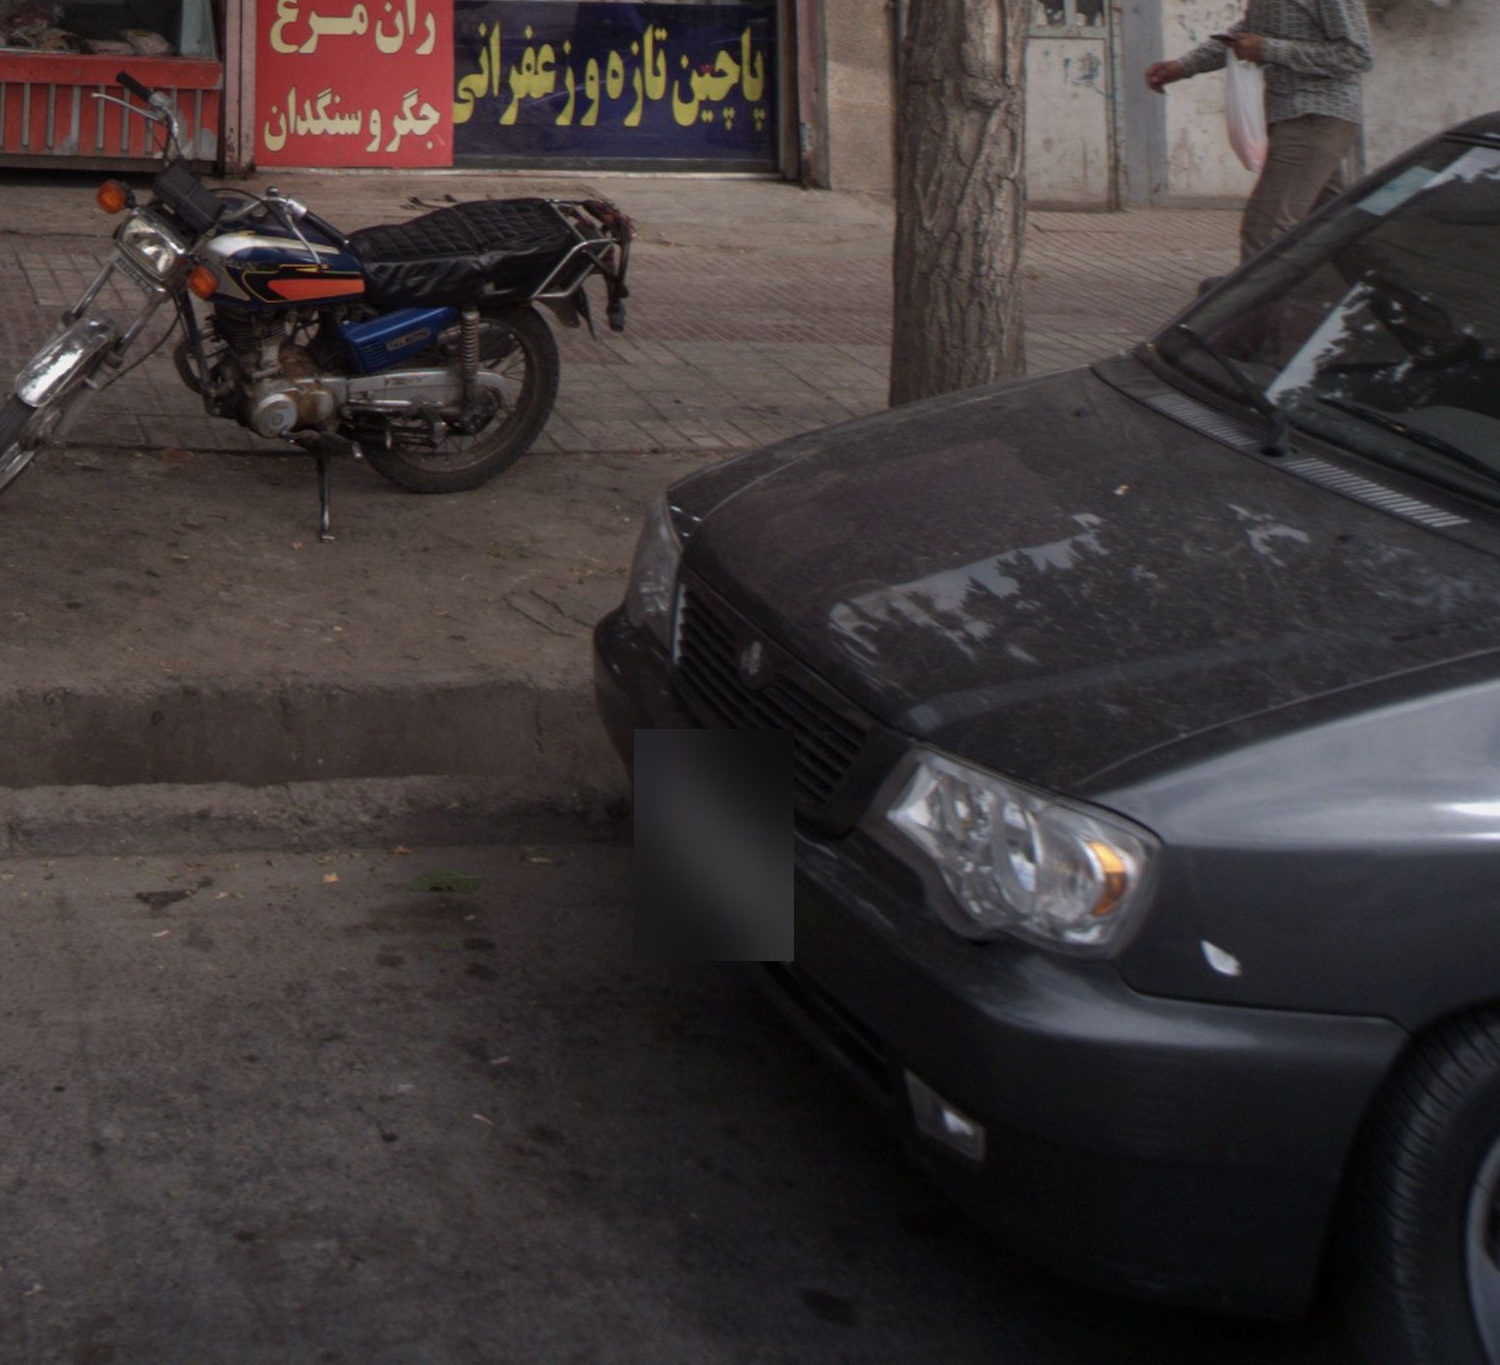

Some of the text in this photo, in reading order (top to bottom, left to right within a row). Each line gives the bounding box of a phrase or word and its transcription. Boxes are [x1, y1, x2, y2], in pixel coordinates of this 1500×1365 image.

[264, 86, 441, 154] جگر و سنگدان
[453, 19, 765, 131] پاچین تازه و زعفرانی
